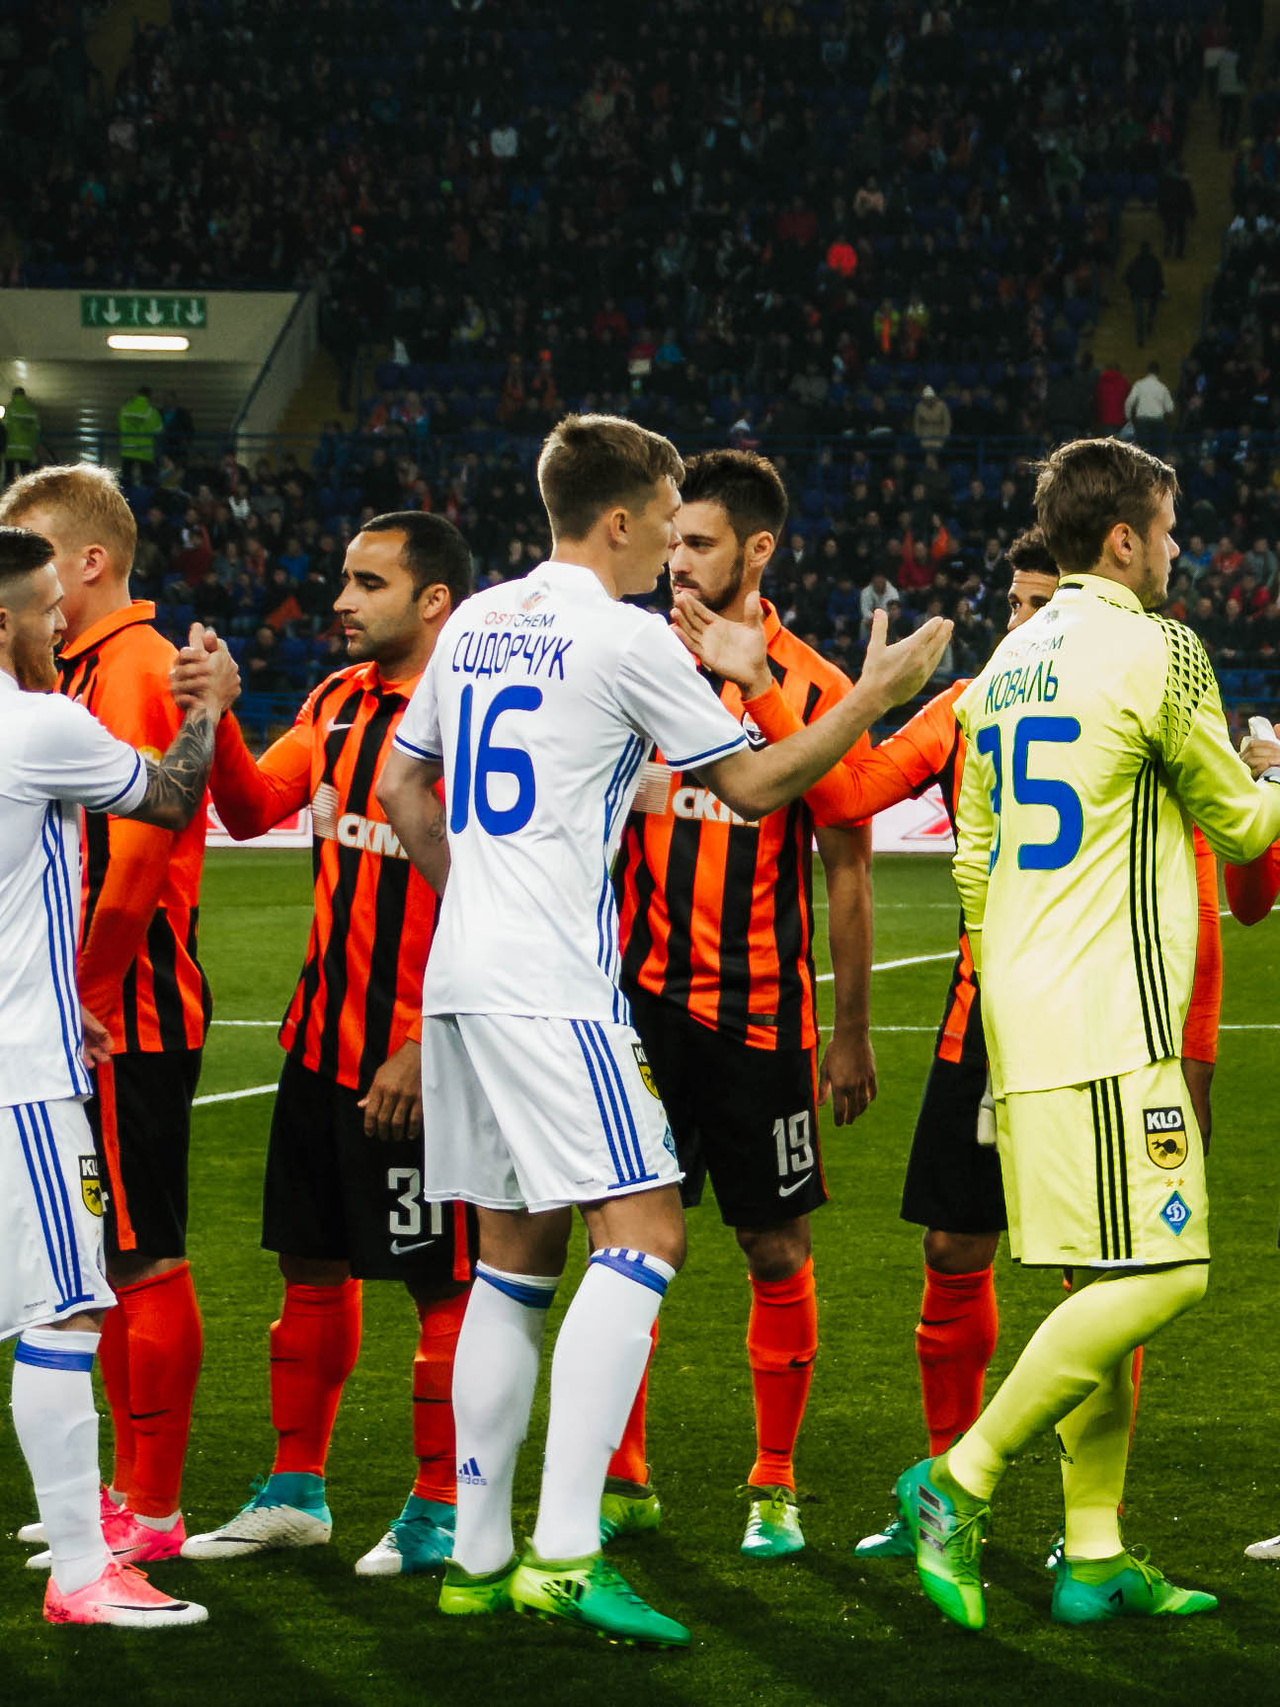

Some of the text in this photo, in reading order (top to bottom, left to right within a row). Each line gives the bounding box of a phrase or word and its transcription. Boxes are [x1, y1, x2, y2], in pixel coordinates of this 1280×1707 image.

[484, 611, 555, 628] OSTCHEM
[452, 631, 573, 680] СИДОРЧУК
[985, 660, 1058, 715] КОВАЛЬ
[450, 683, 543, 836] 16
[772, 1110, 814, 1176] 19
[1146, 1110, 1182, 1130] KLO
[81, 1159, 98, 1177] KL
